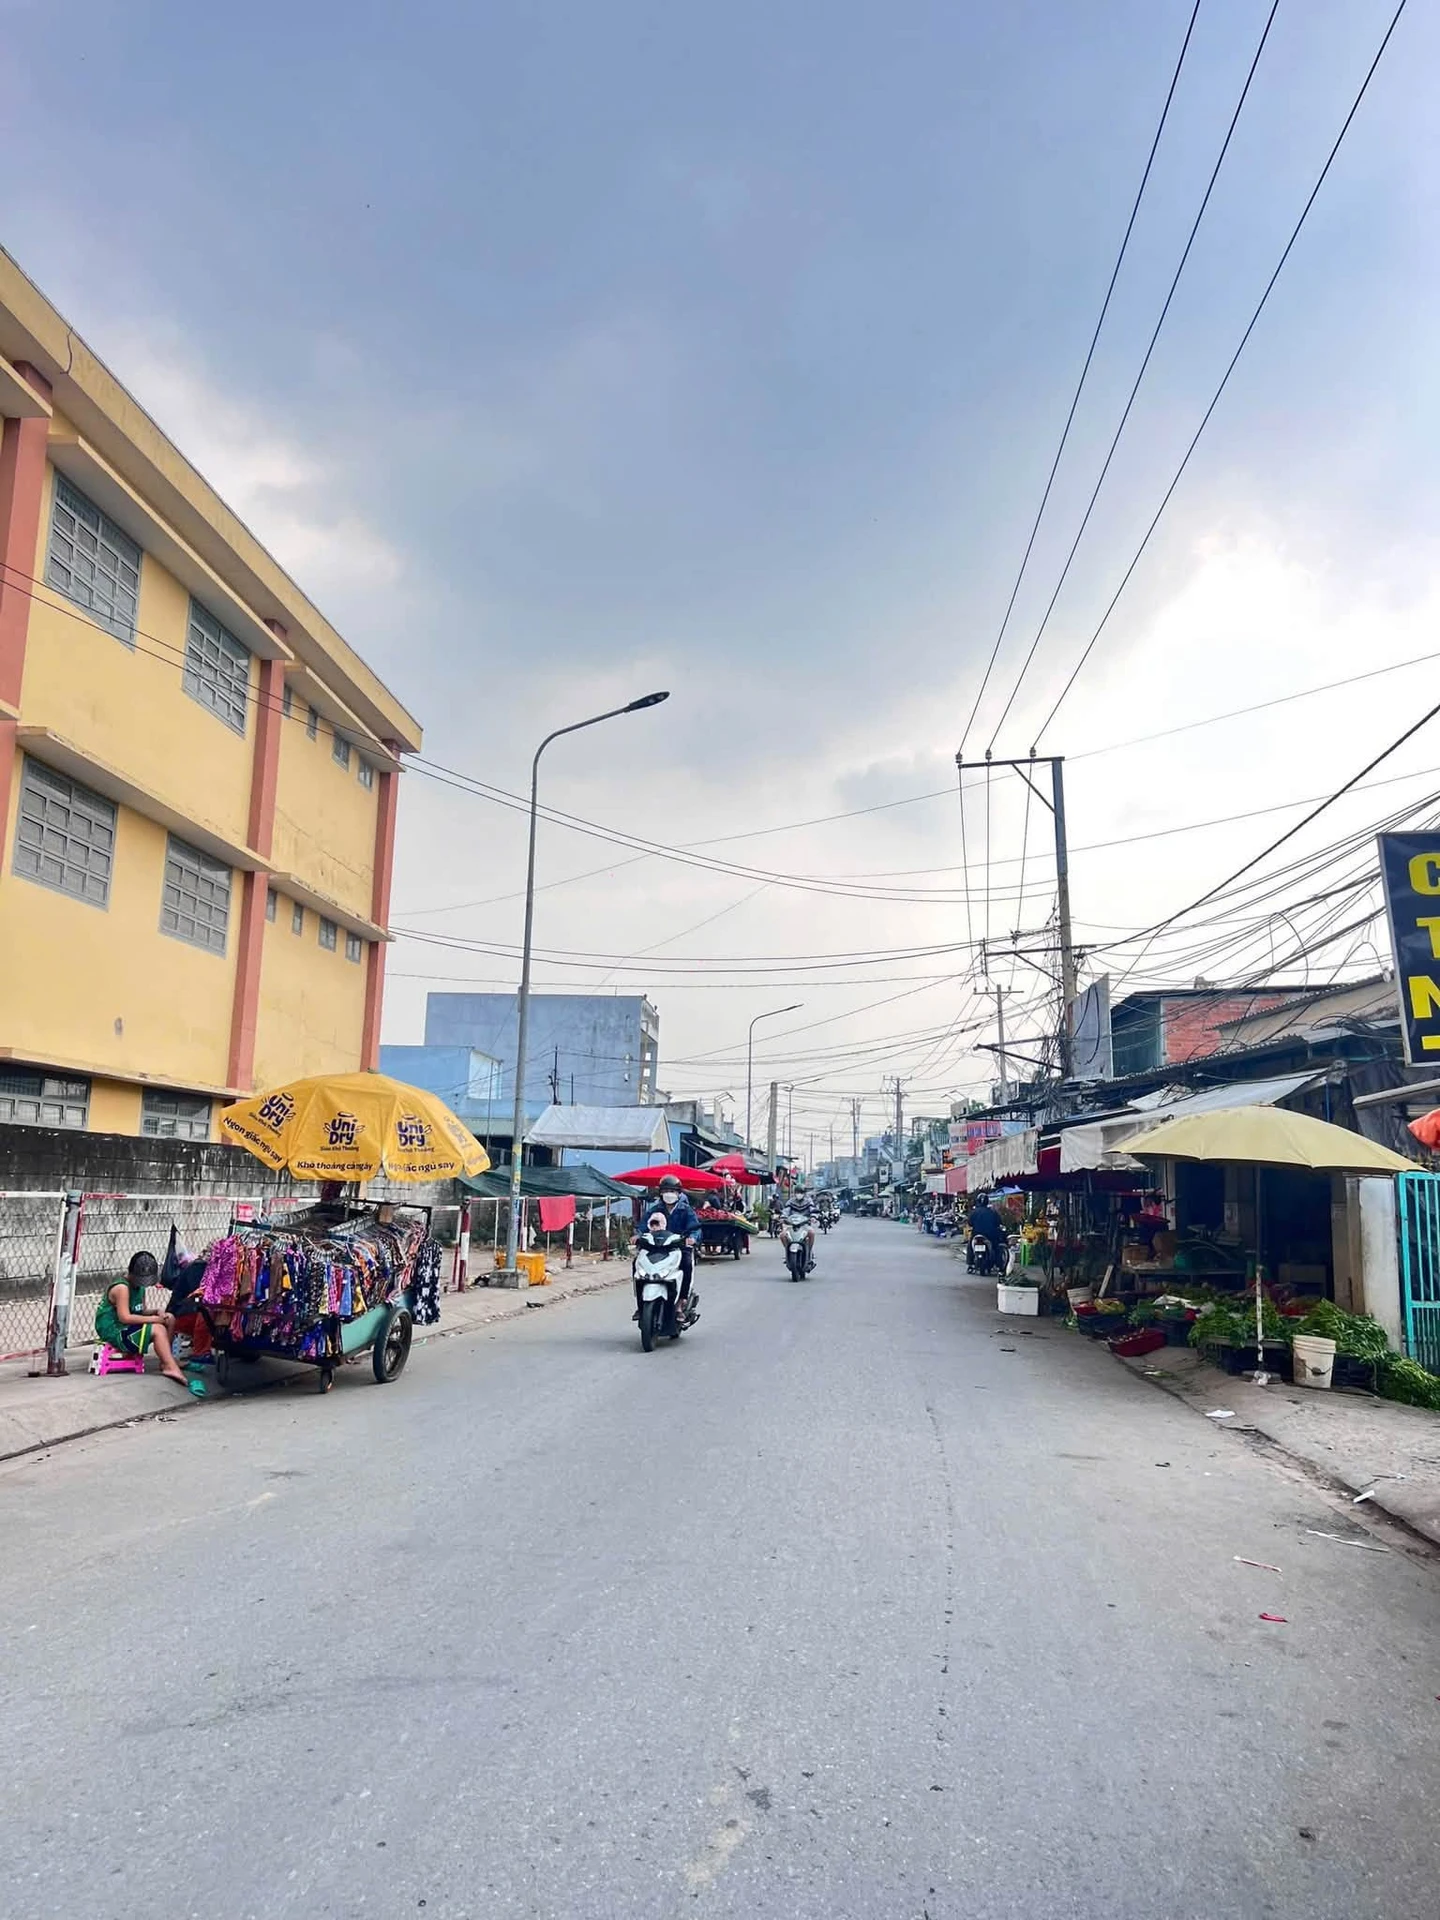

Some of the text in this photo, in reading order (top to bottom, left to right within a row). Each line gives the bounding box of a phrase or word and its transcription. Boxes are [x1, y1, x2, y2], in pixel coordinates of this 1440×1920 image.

[269, 1095, 294, 1116] Uni
[259, 1104, 285, 1127] Dry
[331, 1118, 358, 1131] Uni
[397, 1119, 424, 1134] Uni
[223, 1116, 246, 1135] Ngon
[270, 1151, 283, 1164] say
[329, 1131, 355, 1145] Dry
[398, 1133, 425, 1147] Dry
[438, 1161, 455, 1171] say
